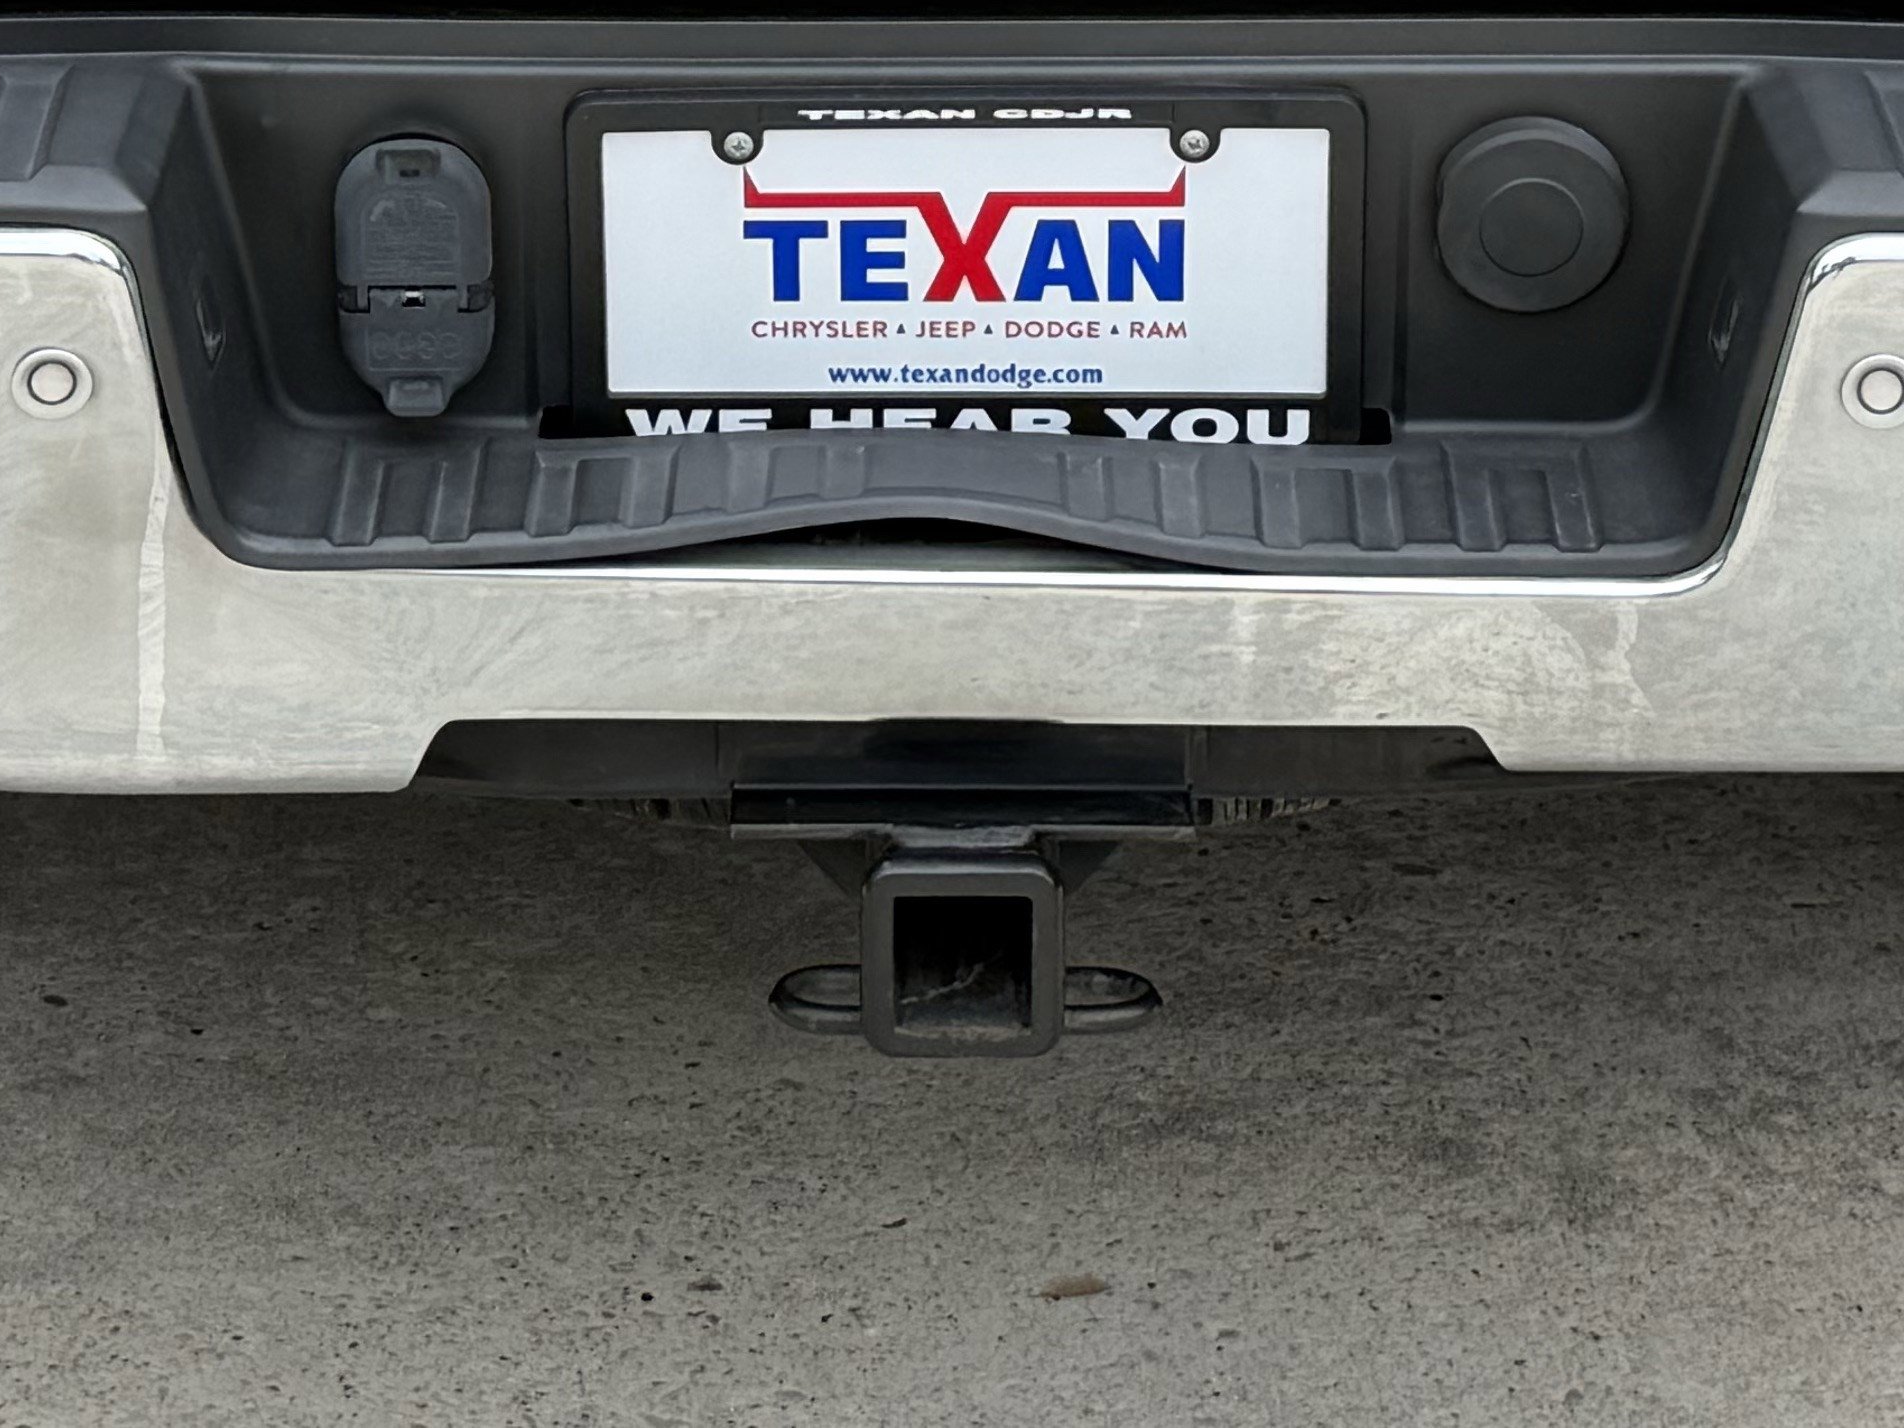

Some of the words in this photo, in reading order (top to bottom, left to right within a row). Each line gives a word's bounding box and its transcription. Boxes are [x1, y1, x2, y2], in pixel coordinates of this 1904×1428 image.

[797, 108, 976, 120] TEXAN
[743, 192, 1186, 303] TEXAN
[750, 320, 888, 339] CHRYSLER
[914, 320, 977, 339] JEEP
[1004, 320, 1102, 339] DODGE
[1128, 320, 1188, 339] RAM
[827, 363, 1104, 389] www.texandodge.com
[625, 408, 773, 436] WE
[1103, 407, 1310, 445] YOU
